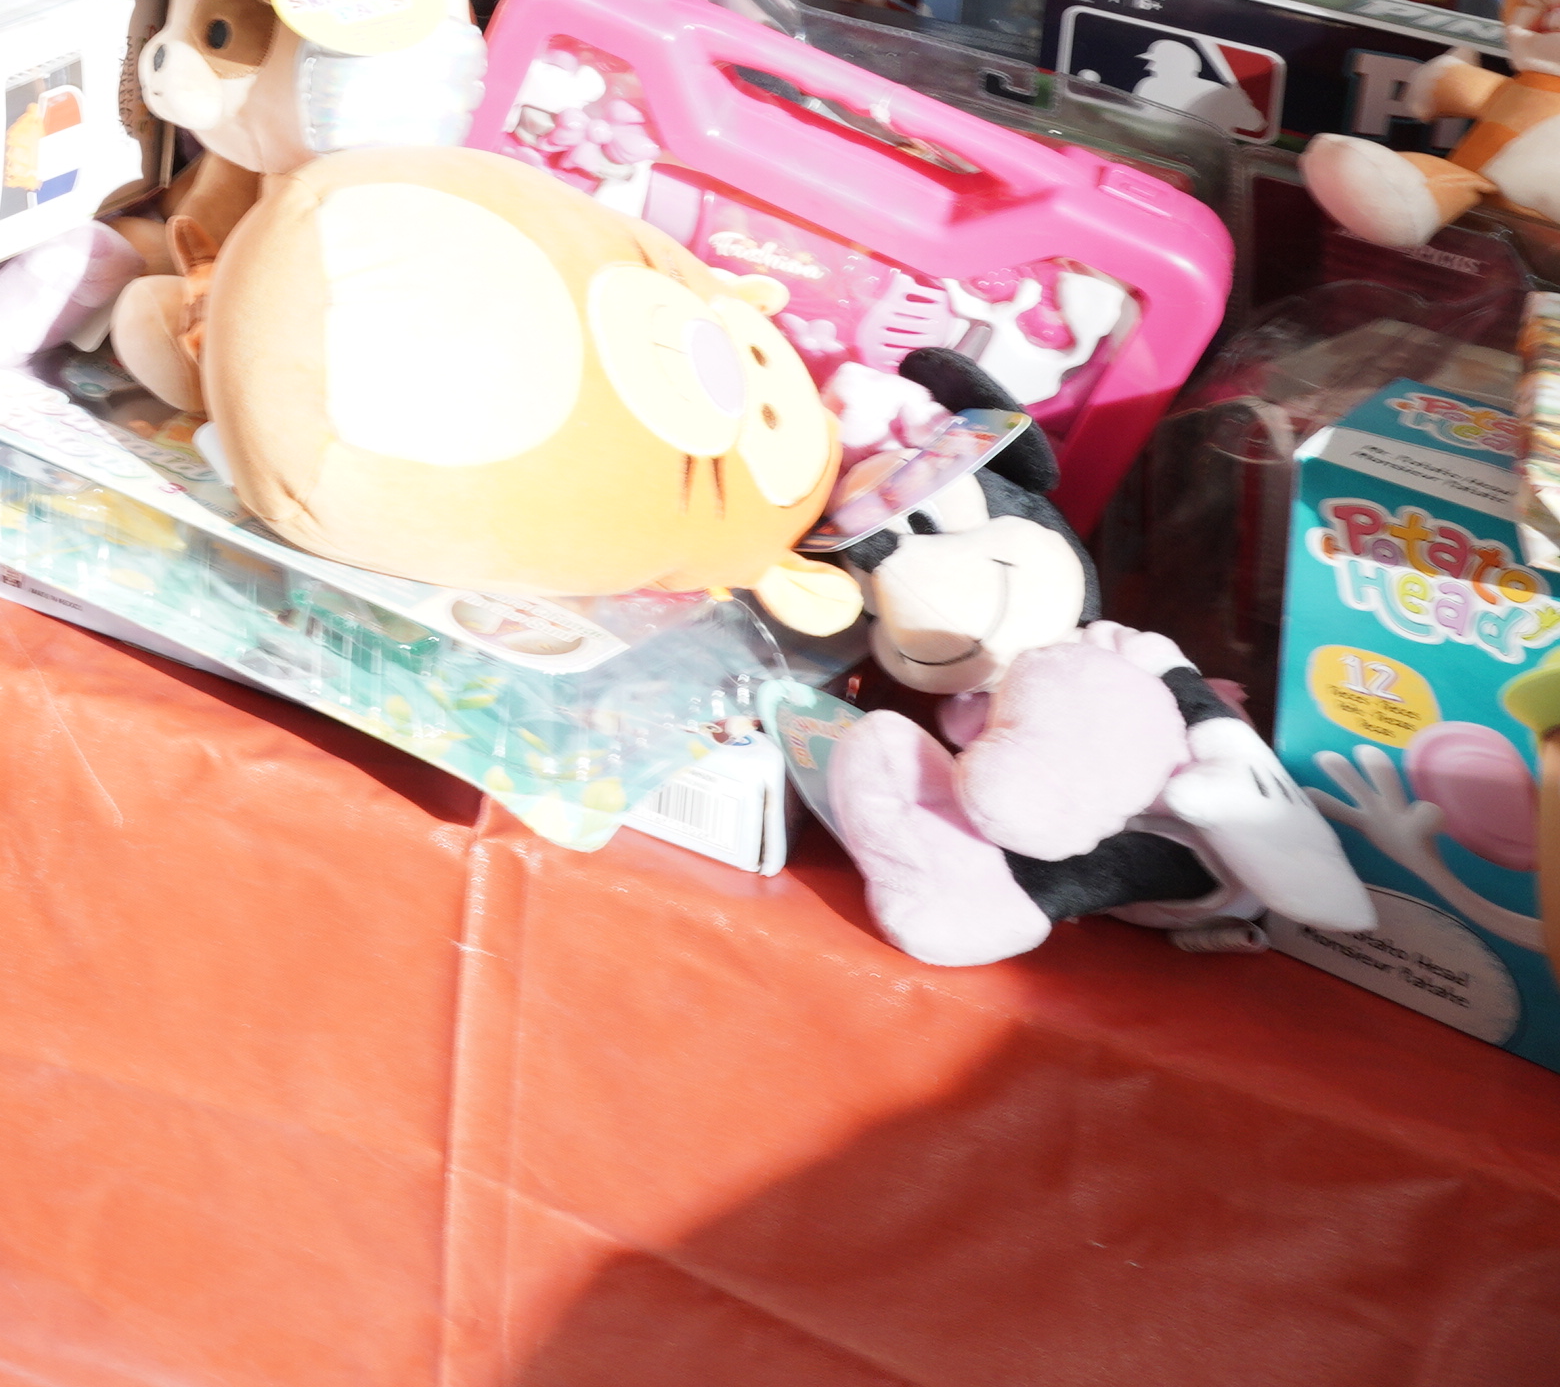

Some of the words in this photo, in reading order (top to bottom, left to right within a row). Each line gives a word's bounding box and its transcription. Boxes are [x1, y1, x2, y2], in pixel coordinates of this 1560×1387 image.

[1331, 503, 1540, 606] Potato
[1349, 558, 1526, 657] Head
[1339, 653, 1406, 704] 12
